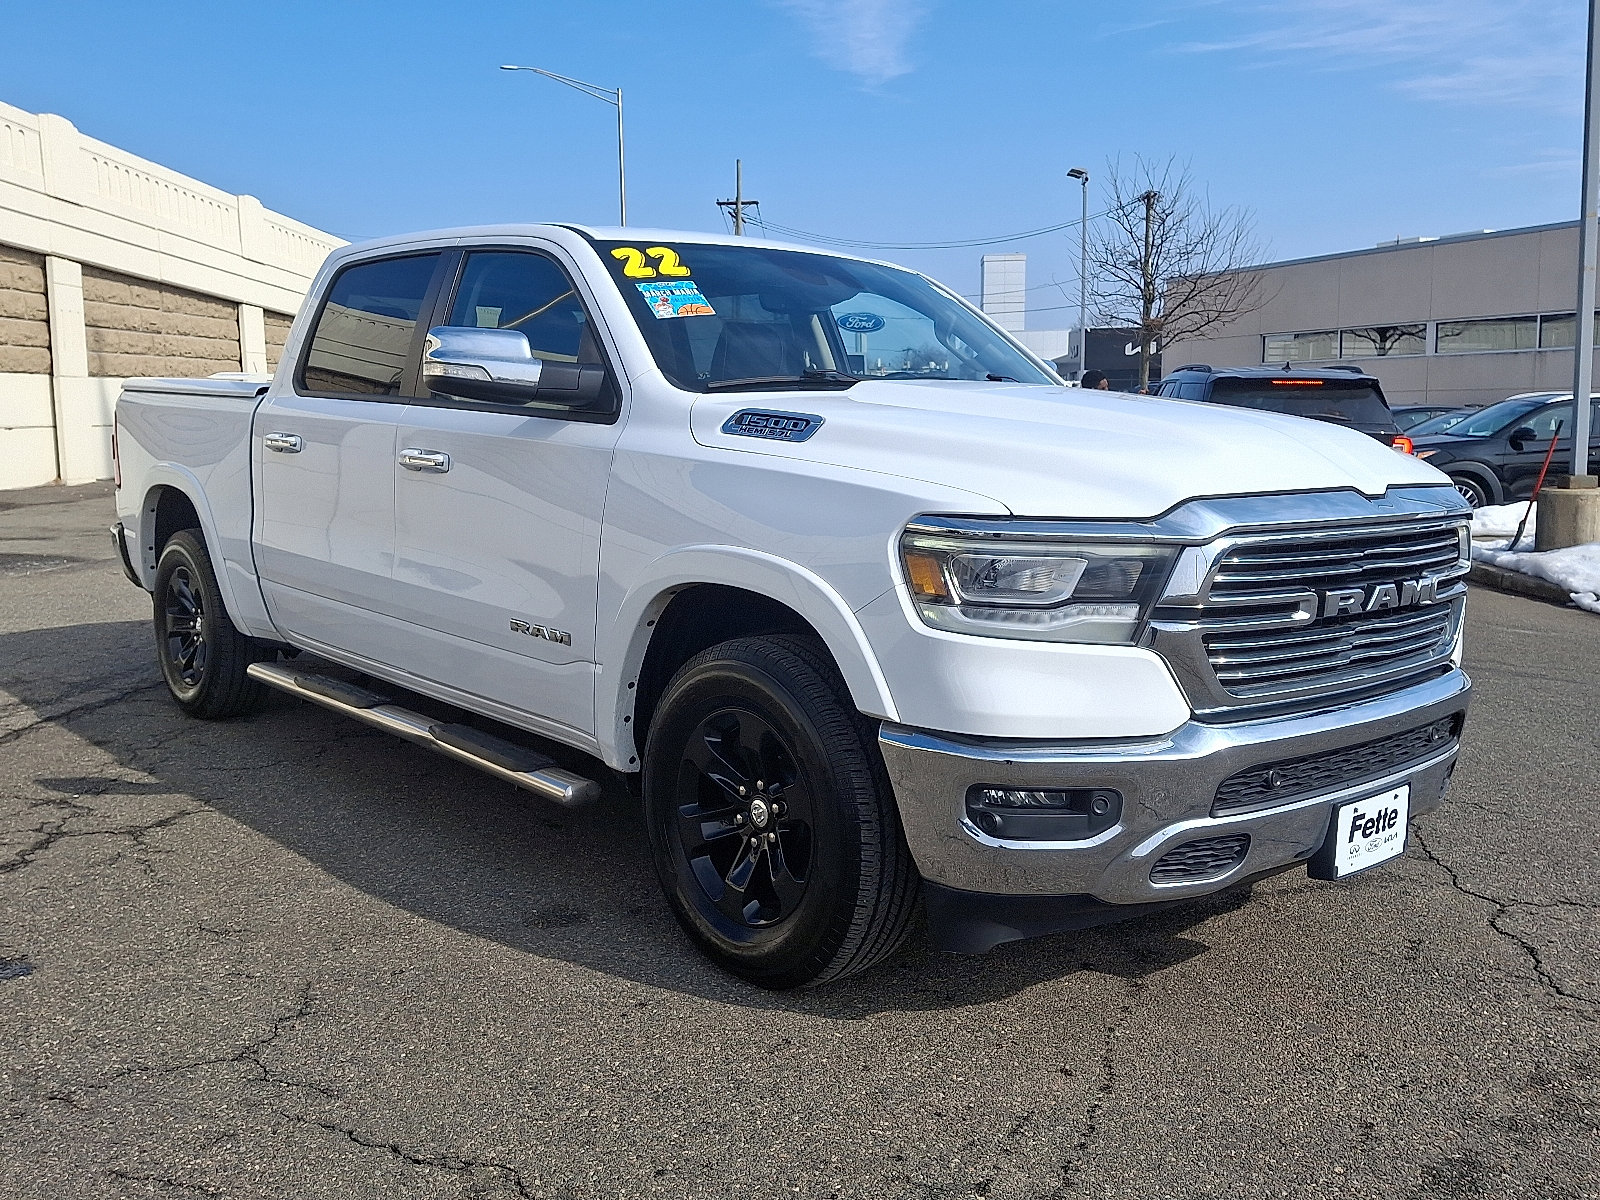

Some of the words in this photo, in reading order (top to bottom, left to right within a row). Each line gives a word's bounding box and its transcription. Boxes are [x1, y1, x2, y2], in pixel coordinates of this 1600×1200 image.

[610, 246, 691, 278] 22
[643, 289, 673, 299] MARCH
[846, 316, 876, 328] Ford
[738, 426, 766, 436] HEMI
[741, 414, 806, 431] 1500
[1324, 577, 1436, 617] RAM
[510, 618, 572, 647] RAM
[1348, 806, 1398, 843] Fette
